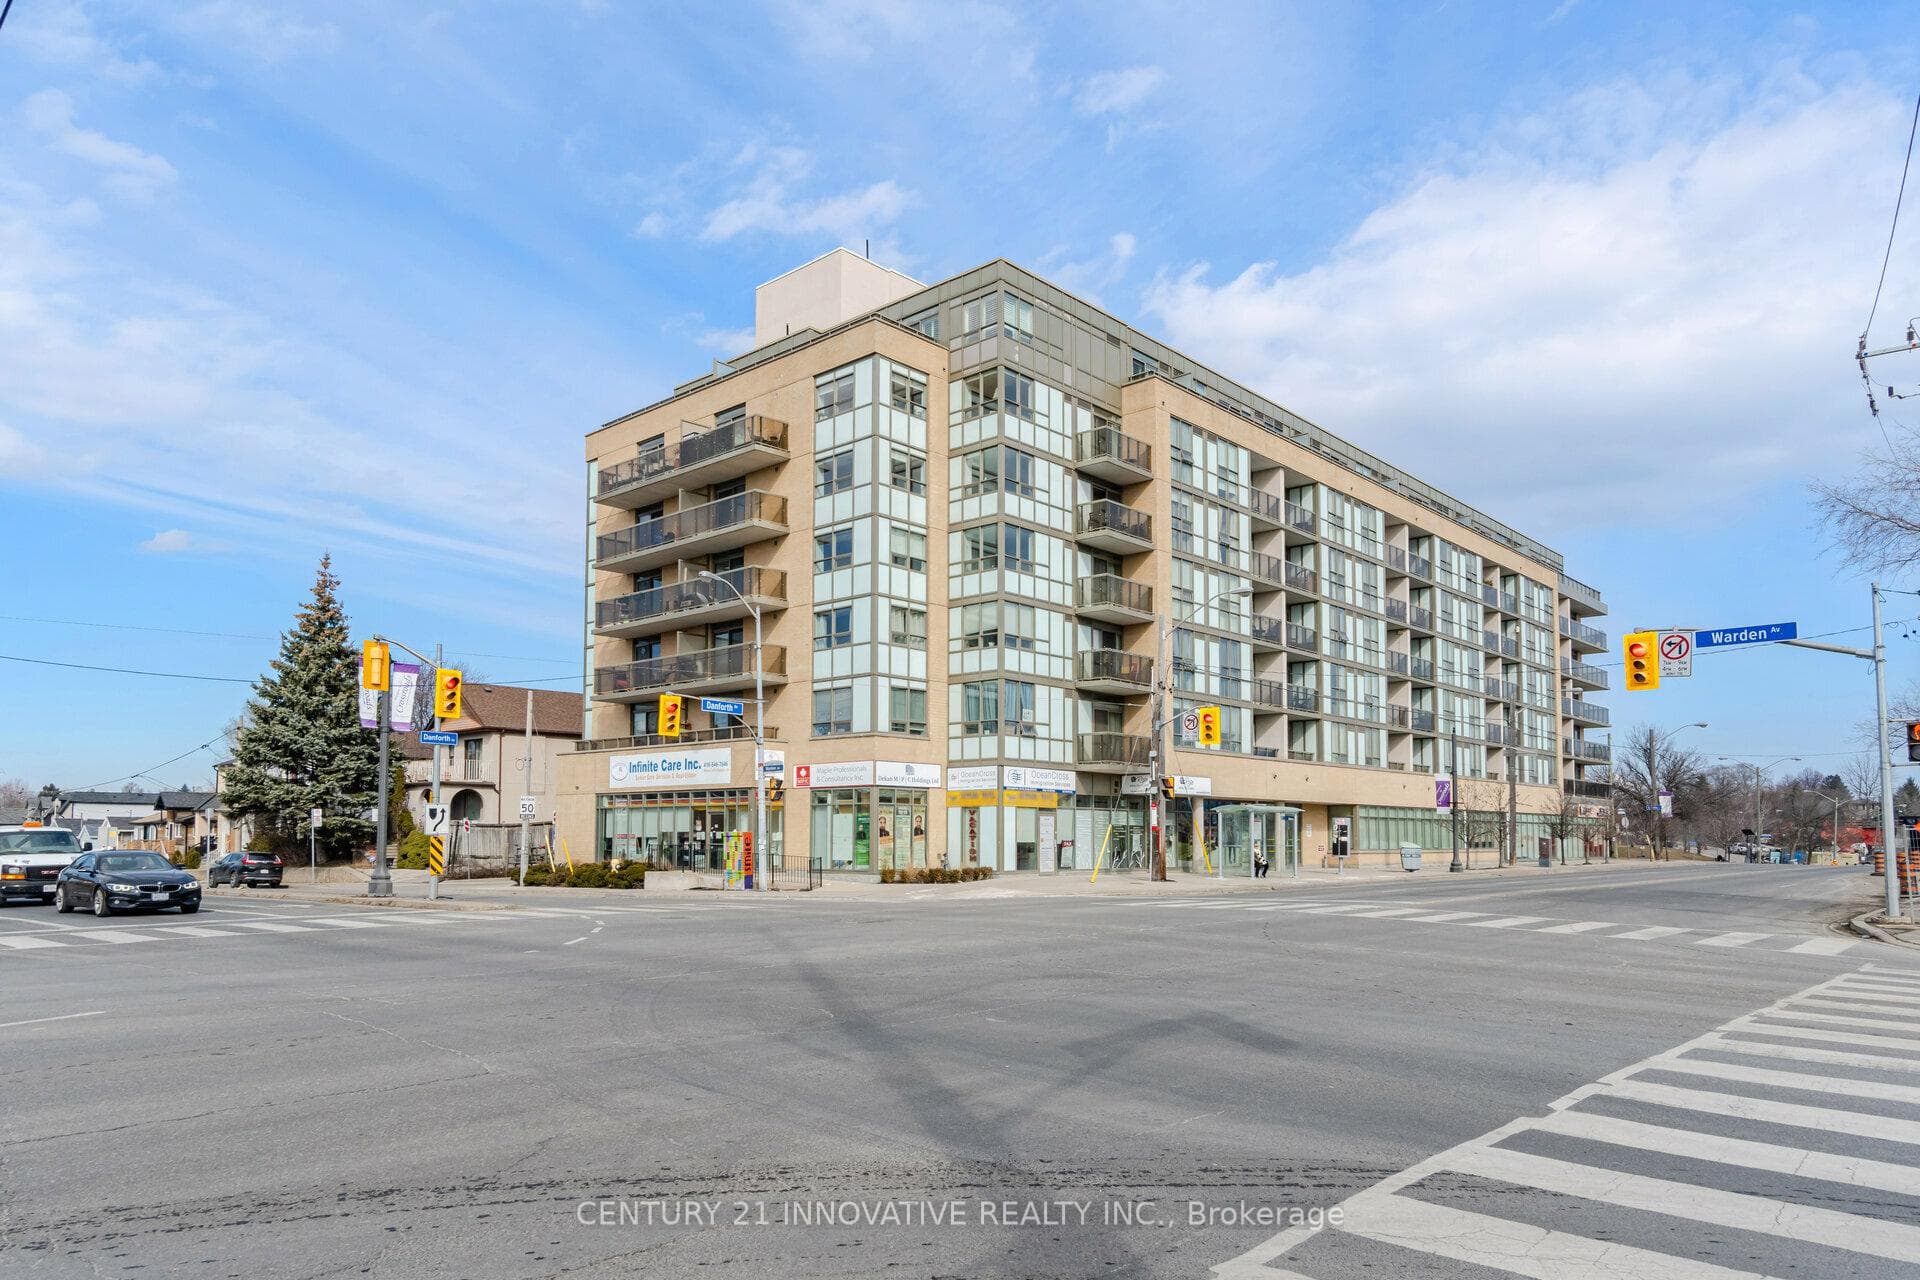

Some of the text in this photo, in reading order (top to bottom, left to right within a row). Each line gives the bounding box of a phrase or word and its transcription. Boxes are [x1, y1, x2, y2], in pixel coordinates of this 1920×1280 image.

[1711, 626, 1781, 644] Warden Av
[706, 701, 734, 712] Danforth
[423, 733, 451, 743] Danforth
[629, 758, 701, 773] Infinite Care Inc.
[521, 803, 534, 813] 50
[968, 809, 977, 862] VACATION
